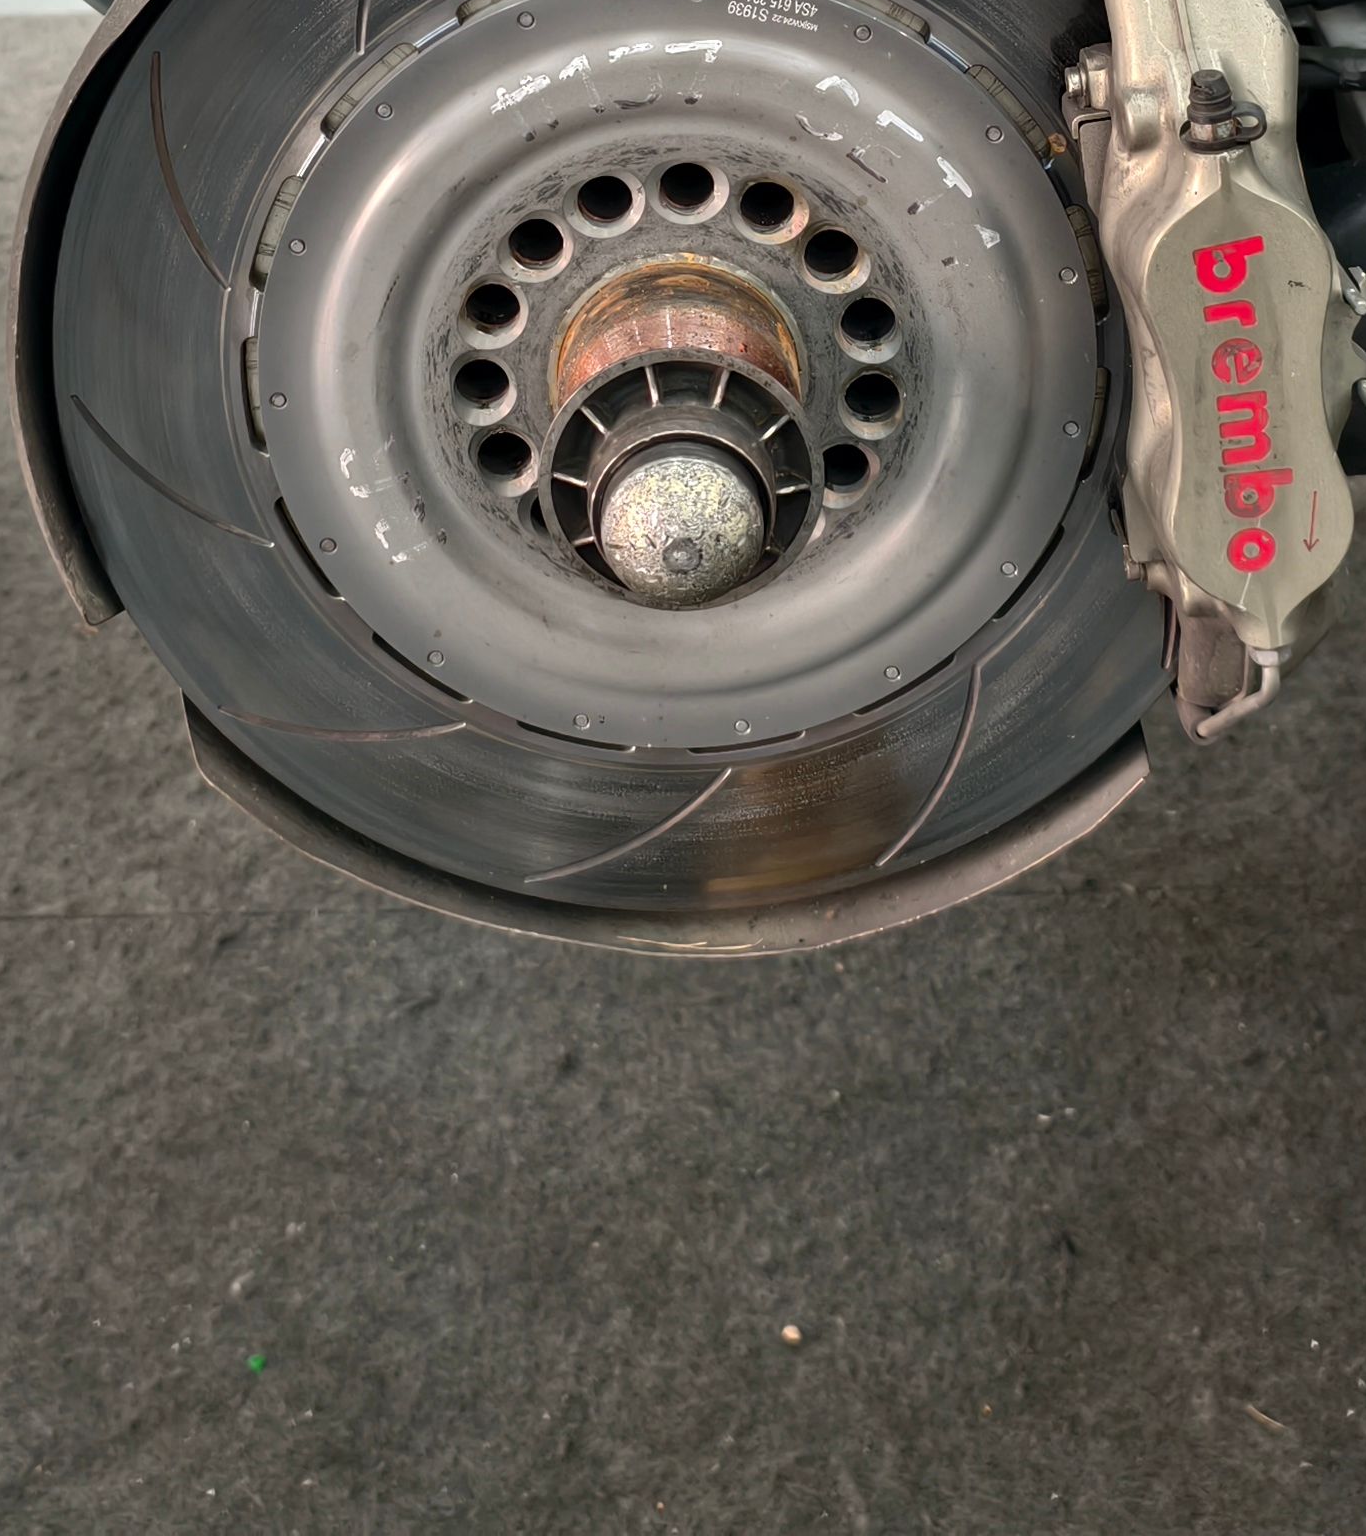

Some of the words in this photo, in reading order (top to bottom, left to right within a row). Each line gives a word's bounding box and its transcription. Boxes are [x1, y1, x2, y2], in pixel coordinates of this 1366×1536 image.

[727, 0, 769, 23] S1939
[794, 0, 818, 18] 4SA
[1193, 235, 1293, 573] brembo
